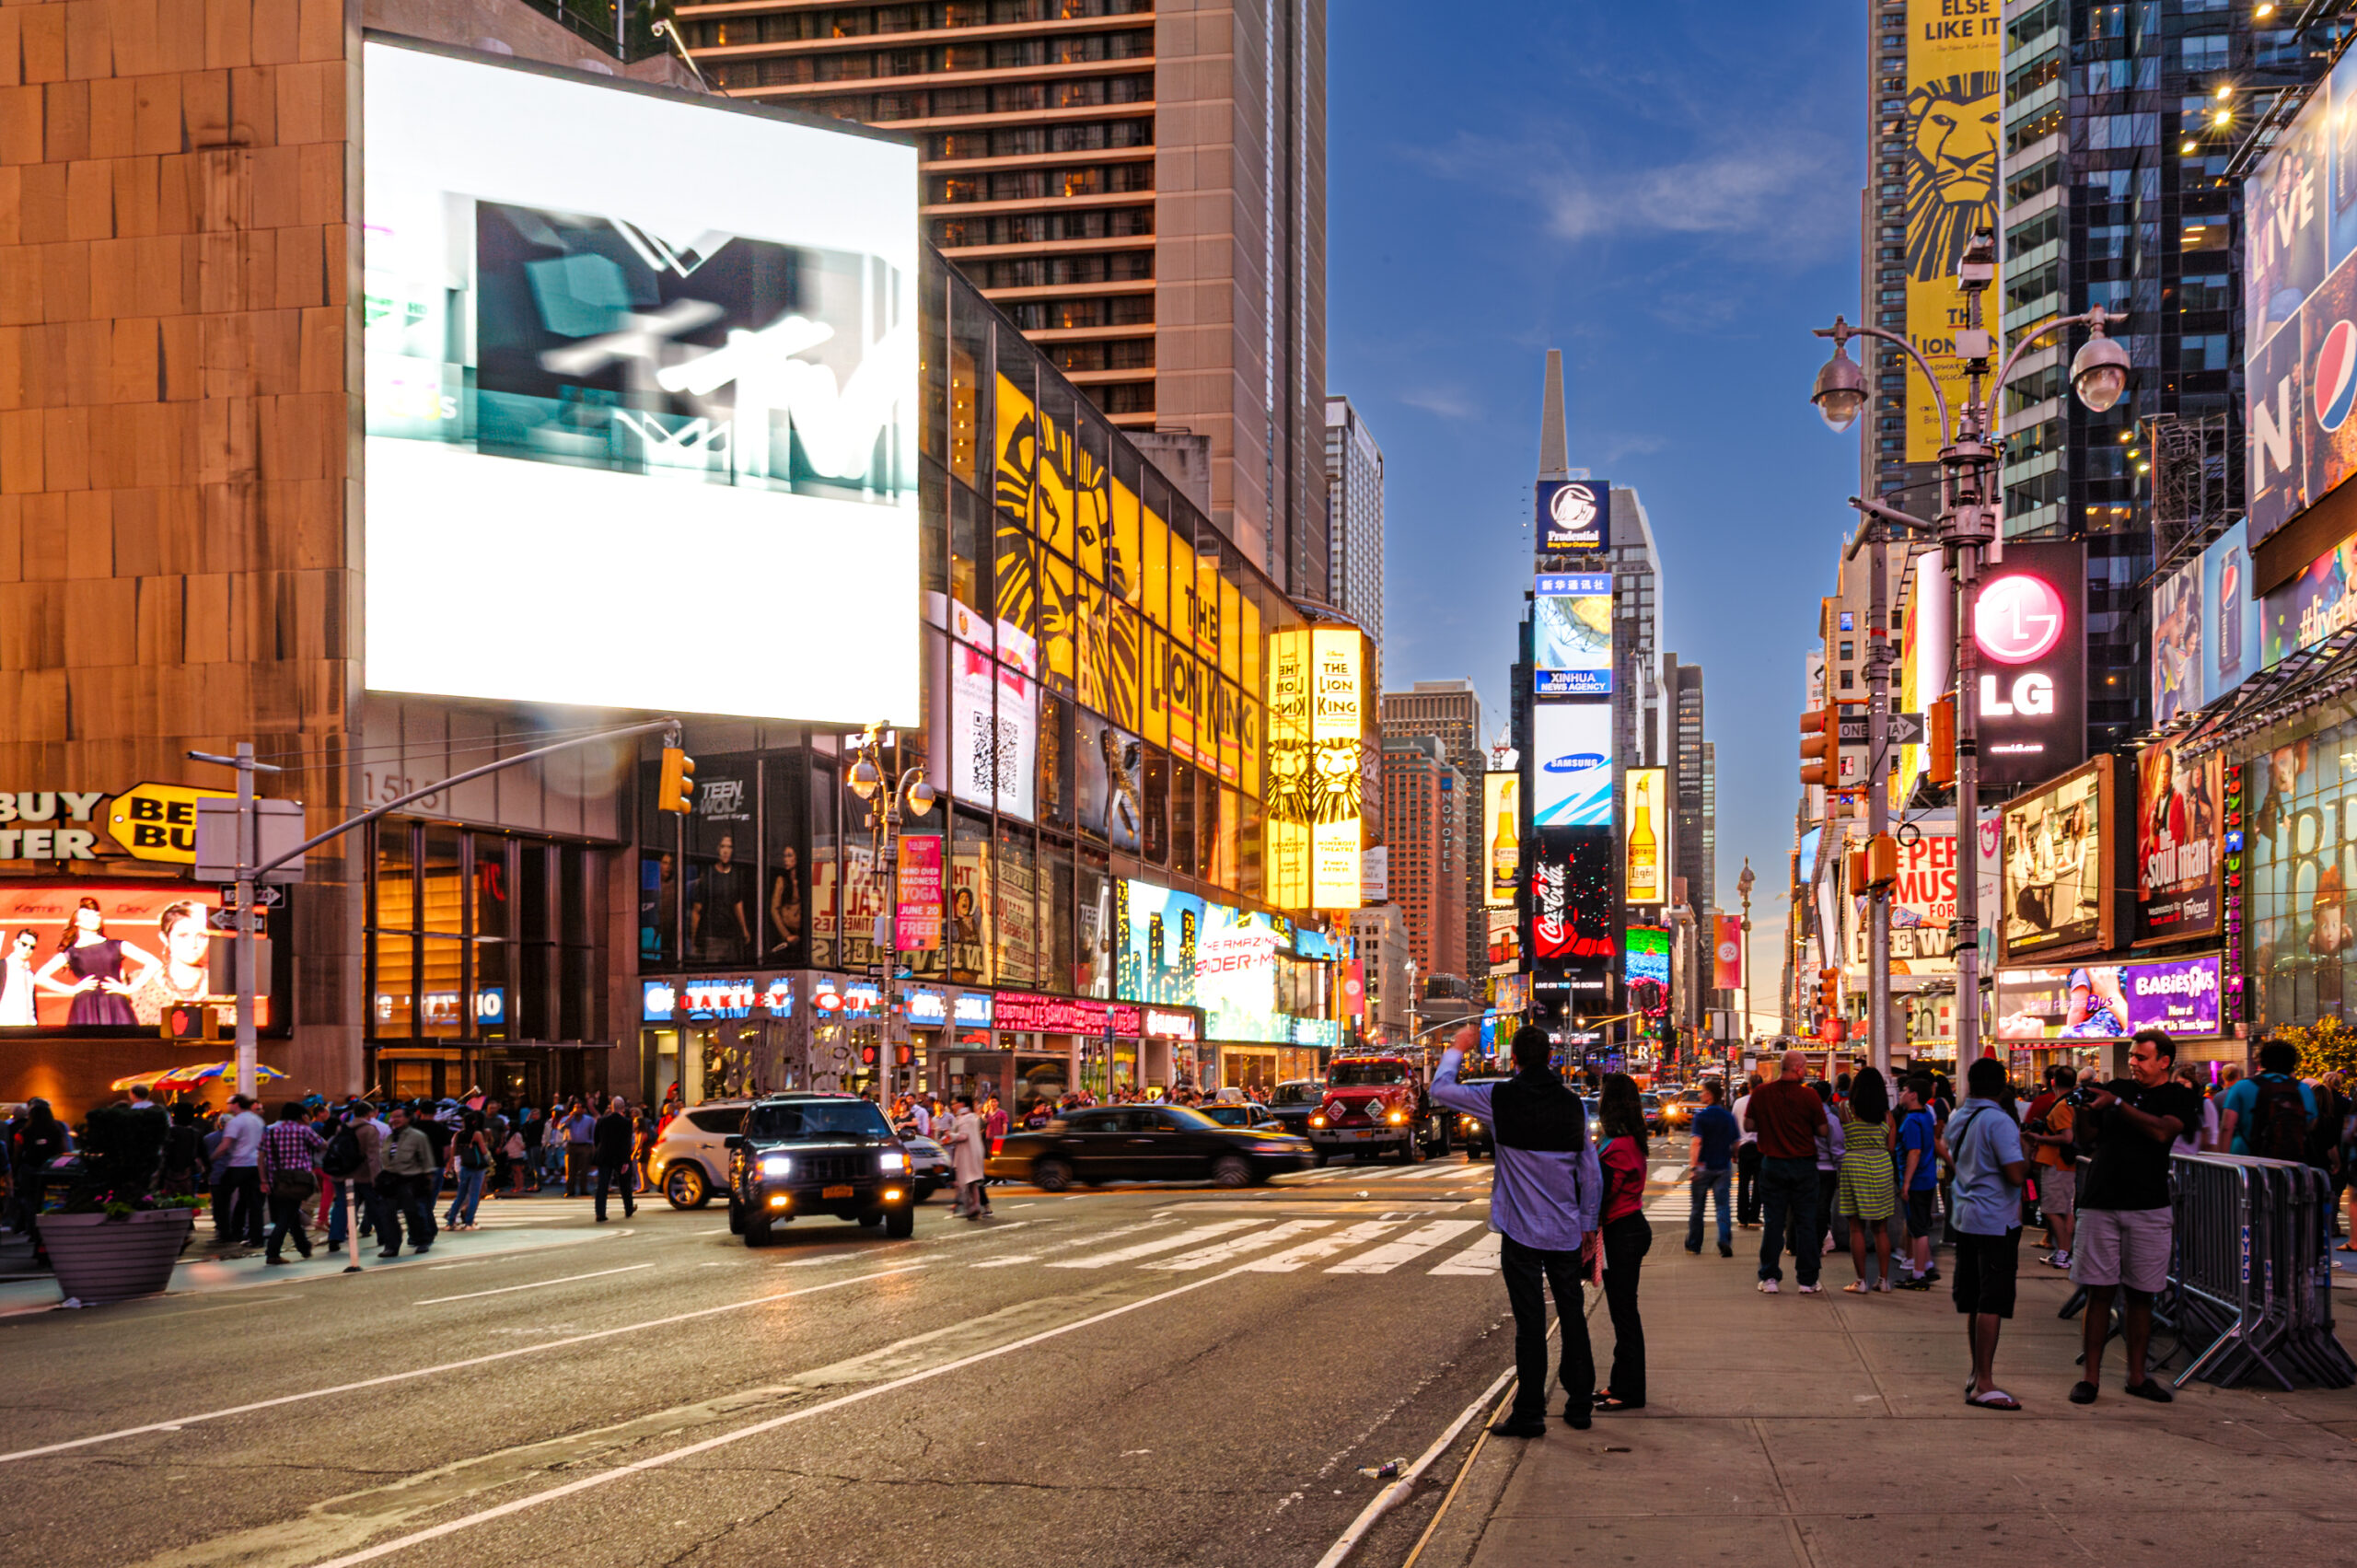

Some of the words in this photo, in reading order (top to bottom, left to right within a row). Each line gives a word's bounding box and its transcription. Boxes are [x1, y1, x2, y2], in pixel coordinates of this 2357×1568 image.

[1942, 0, 1990, 17] ELSE
[1925, 19, 1973, 41] LIKE
[1982, 17, 2001, 36] IT
[2253, 168, 2315, 285] LIVE
[1548, 529, 1600, 541] Prudential
[1541, 579, 1605, 591] 新华通讯社
[1185, 585, 1217, 645] THE
[1323, 663, 1348, 673] THE
[1151, 612, 1202, 717] LION
[1206, 655, 1253, 749] KING
[1319, 676, 1353, 693] LION
[1541, 683, 1567, 691] NEWS
[1569, 682, 1607, 691] AGENCY
[1550, 673, 1596, 683] XINHUA
[1980, 673, 2054, 715] LG
[1318, 696, 1356, 715] KING
[1842, 725, 1868, 737] ONE
[1887, 724, 1910, 737] AY
[1550, 757, 1598, 768] SAMSUNG
[365, 771, 438, 809] 1515
[702, 780, 743, 798] TEEN
[2228, 765, 2242, 826] TOYS
[0, 792, 105, 821] BUY
[131, 796, 194, 825] BE
[700, 796, 745, 815] WOLF
[134, 823, 196, 851] BU
[1442, 793, 1452, 872] NOVOTEL
[2159, 829, 2172, 850] the
[2148, 839, 2176, 889] soul
[2178, 838, 2209, 880] man
[900, 877, 939, 885] MADNESS
[901, 887, 939, 900] YOGA
[117, 904, 150, 914] Dev
[900, 906, 923, 915] JUNE
[927, 906, 939, 915] 20
[1929, 903, 1956, 918] FOR
[899, 922, 939, 935] FREE!
[1223, 935, 1280, 949] AMAZING
[679, 993, 785, 1009] OAKLEY
[2241, 1226, 2250, 1282] NYPD
